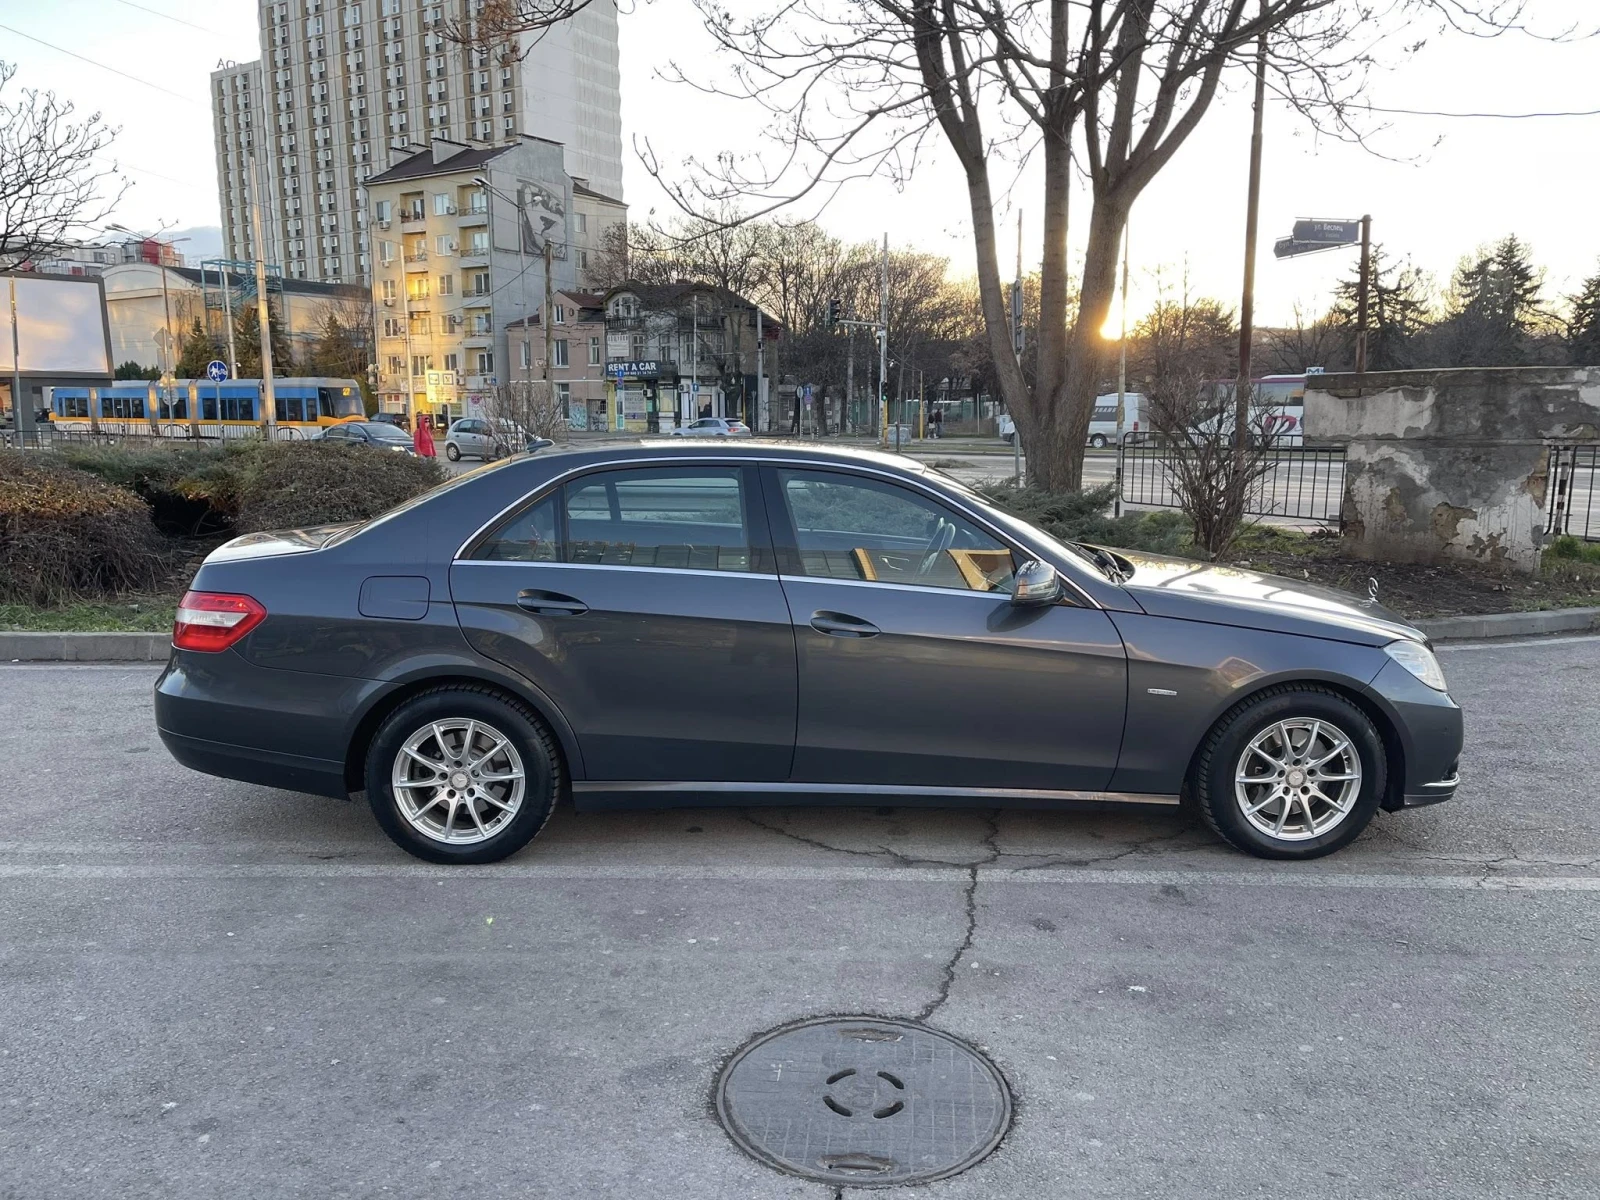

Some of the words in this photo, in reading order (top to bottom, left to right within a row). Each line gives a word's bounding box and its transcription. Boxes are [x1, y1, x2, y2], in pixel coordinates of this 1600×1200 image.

[608, 363, 629, 372] RENT
[631, 363, 638, 371] A
[639, 362, 657, 371] CAR
